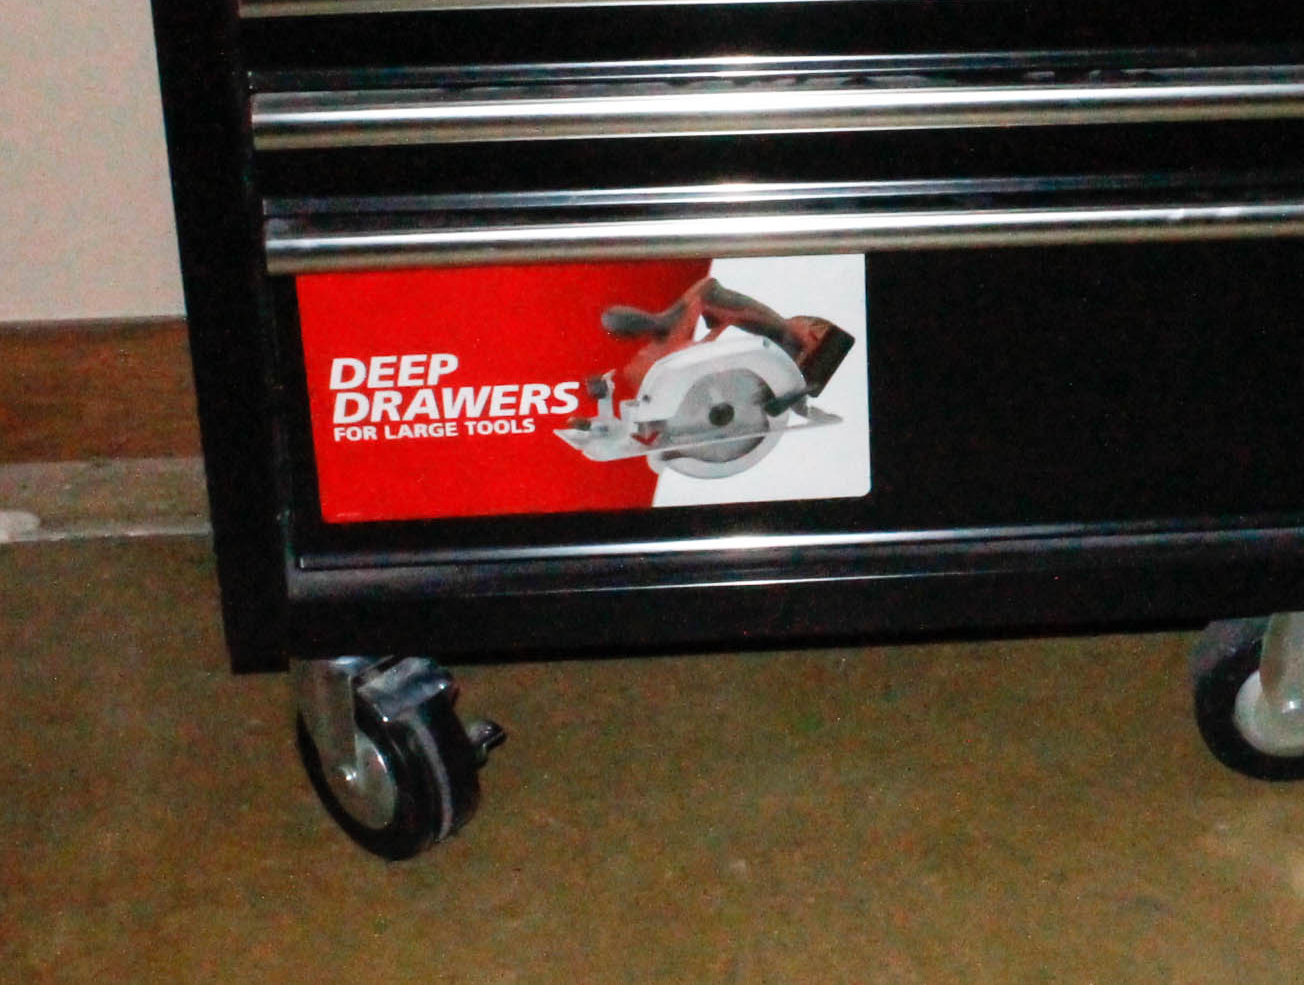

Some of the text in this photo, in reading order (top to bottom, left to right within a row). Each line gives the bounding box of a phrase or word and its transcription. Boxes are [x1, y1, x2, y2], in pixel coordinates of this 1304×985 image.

[329, 353, 459, 390] DEEP
[332, 381, 580, 424] DRAWERS
[333, 418, 536, 442] FOR LARGE TOOLS
